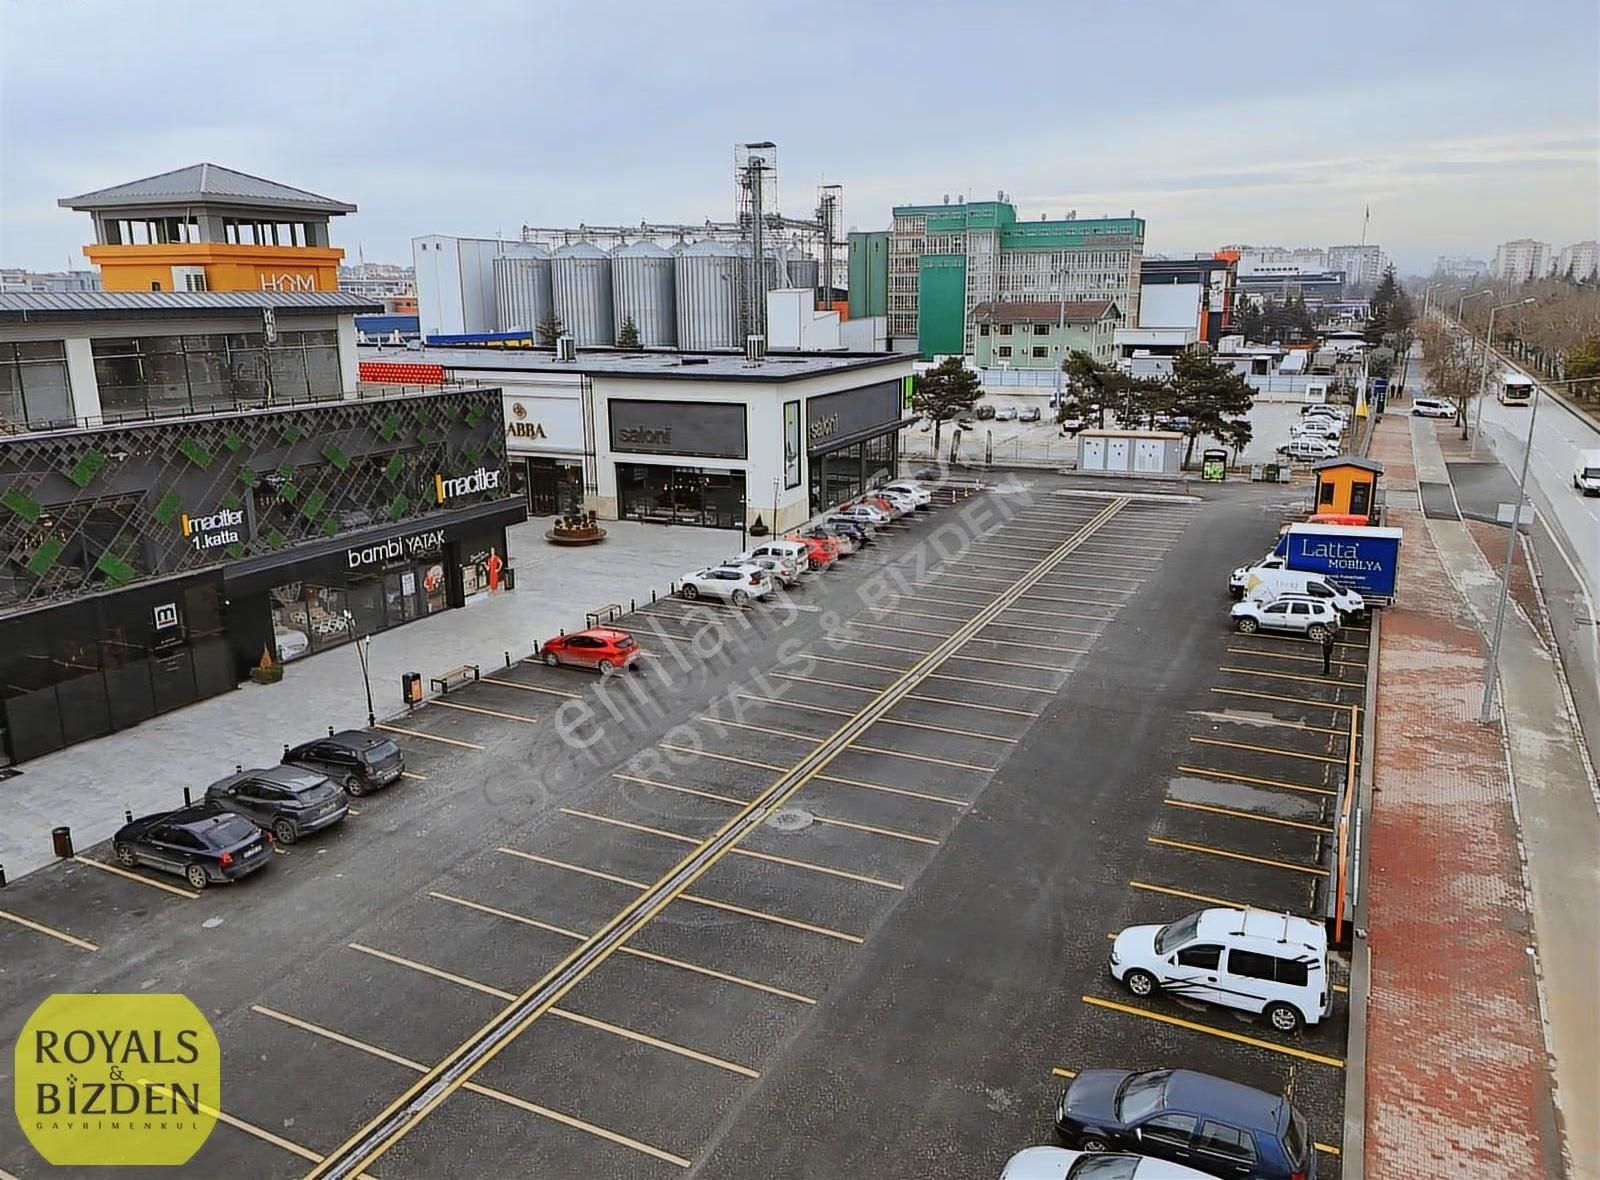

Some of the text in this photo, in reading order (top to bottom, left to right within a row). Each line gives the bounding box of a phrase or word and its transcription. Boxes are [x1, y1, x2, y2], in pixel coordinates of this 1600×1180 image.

[506, 421, 548, 440] ABBA
[192, 529, 239, 550] 1.katta
[347, 536, 404, 569] bambi
[405, 529, 446, 553] YATAK
[1300, 538, 1360, 559] Latta
